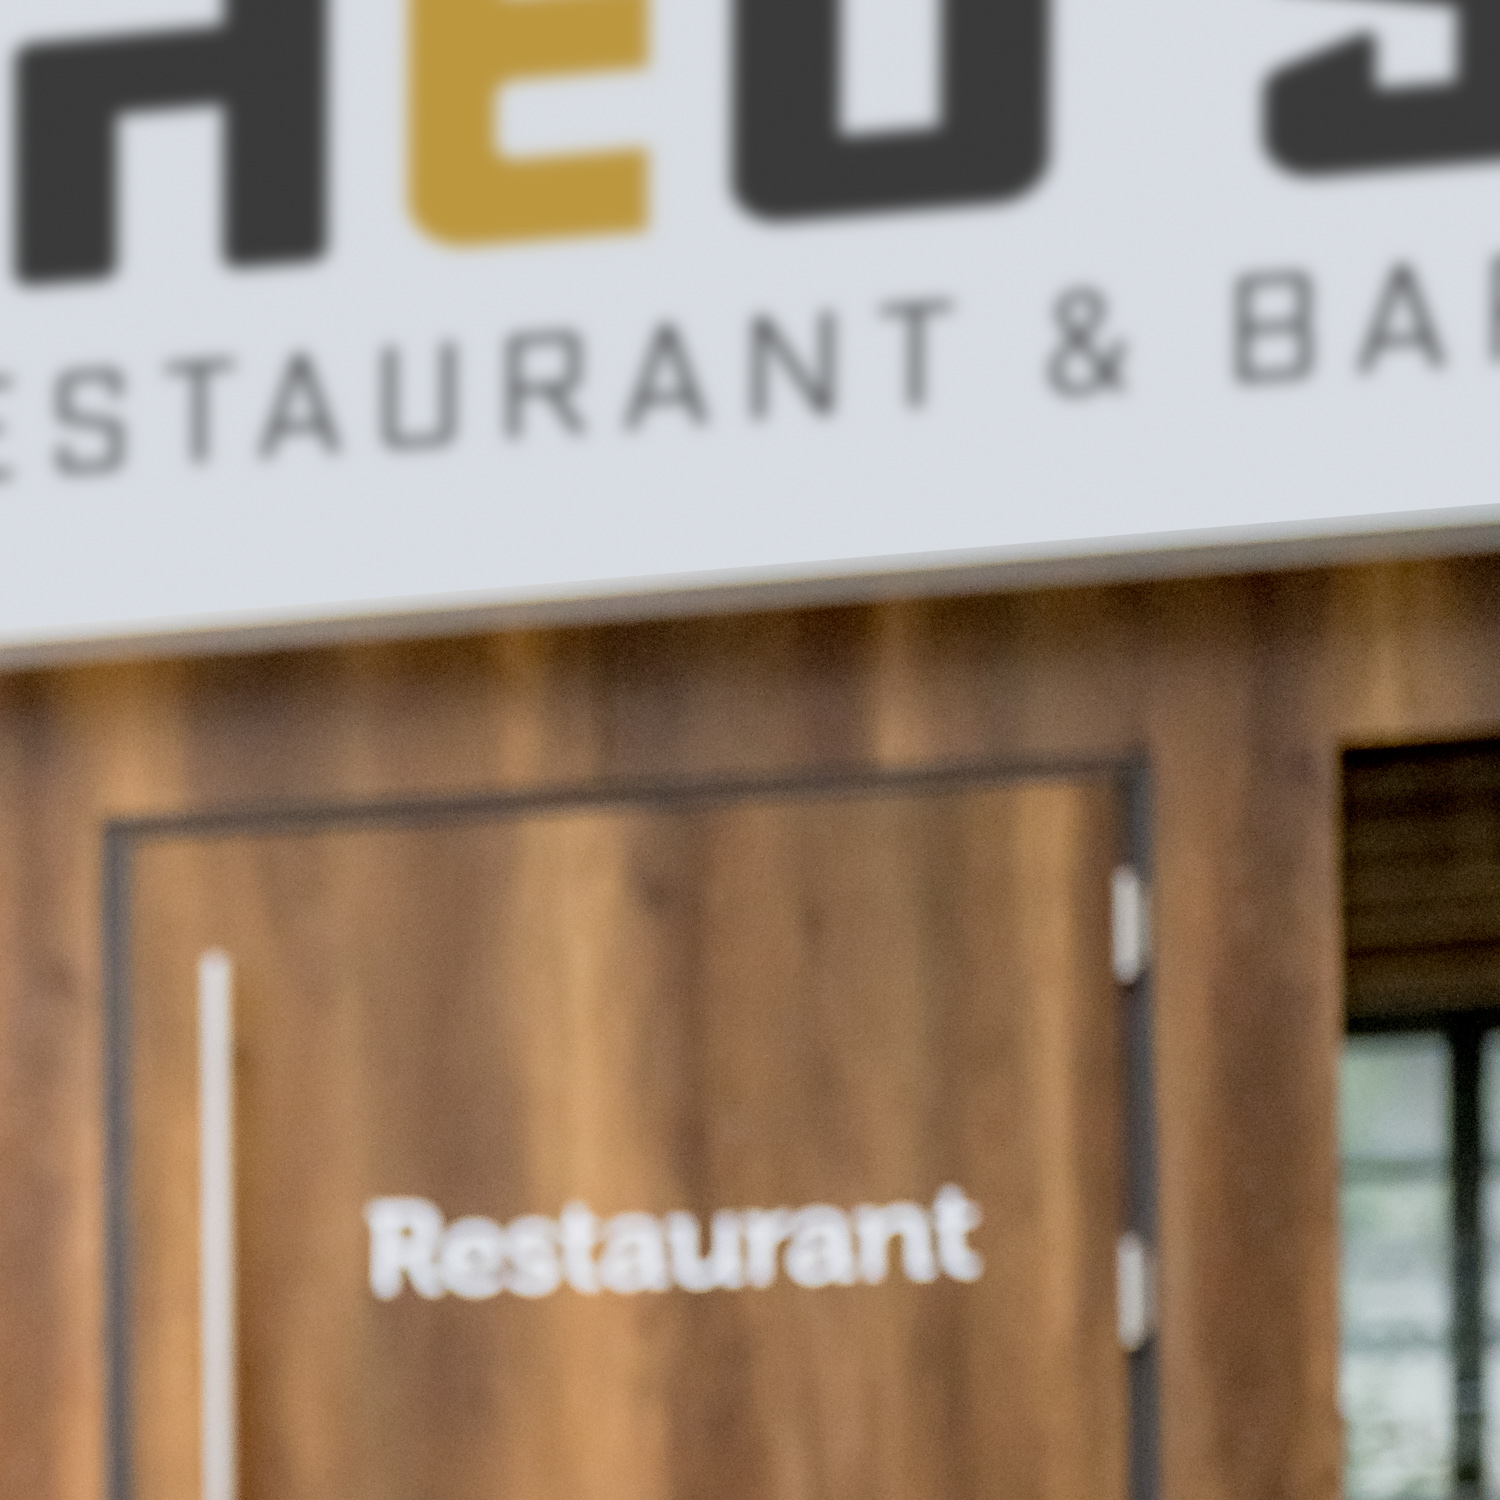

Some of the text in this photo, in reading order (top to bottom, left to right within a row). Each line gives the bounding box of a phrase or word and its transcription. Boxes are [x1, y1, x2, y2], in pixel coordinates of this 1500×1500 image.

[1046, 286, 1126, 399] &
[1231, 253, 1500, 387] BA
[365, 1183, 982, 1300] Restaurant
